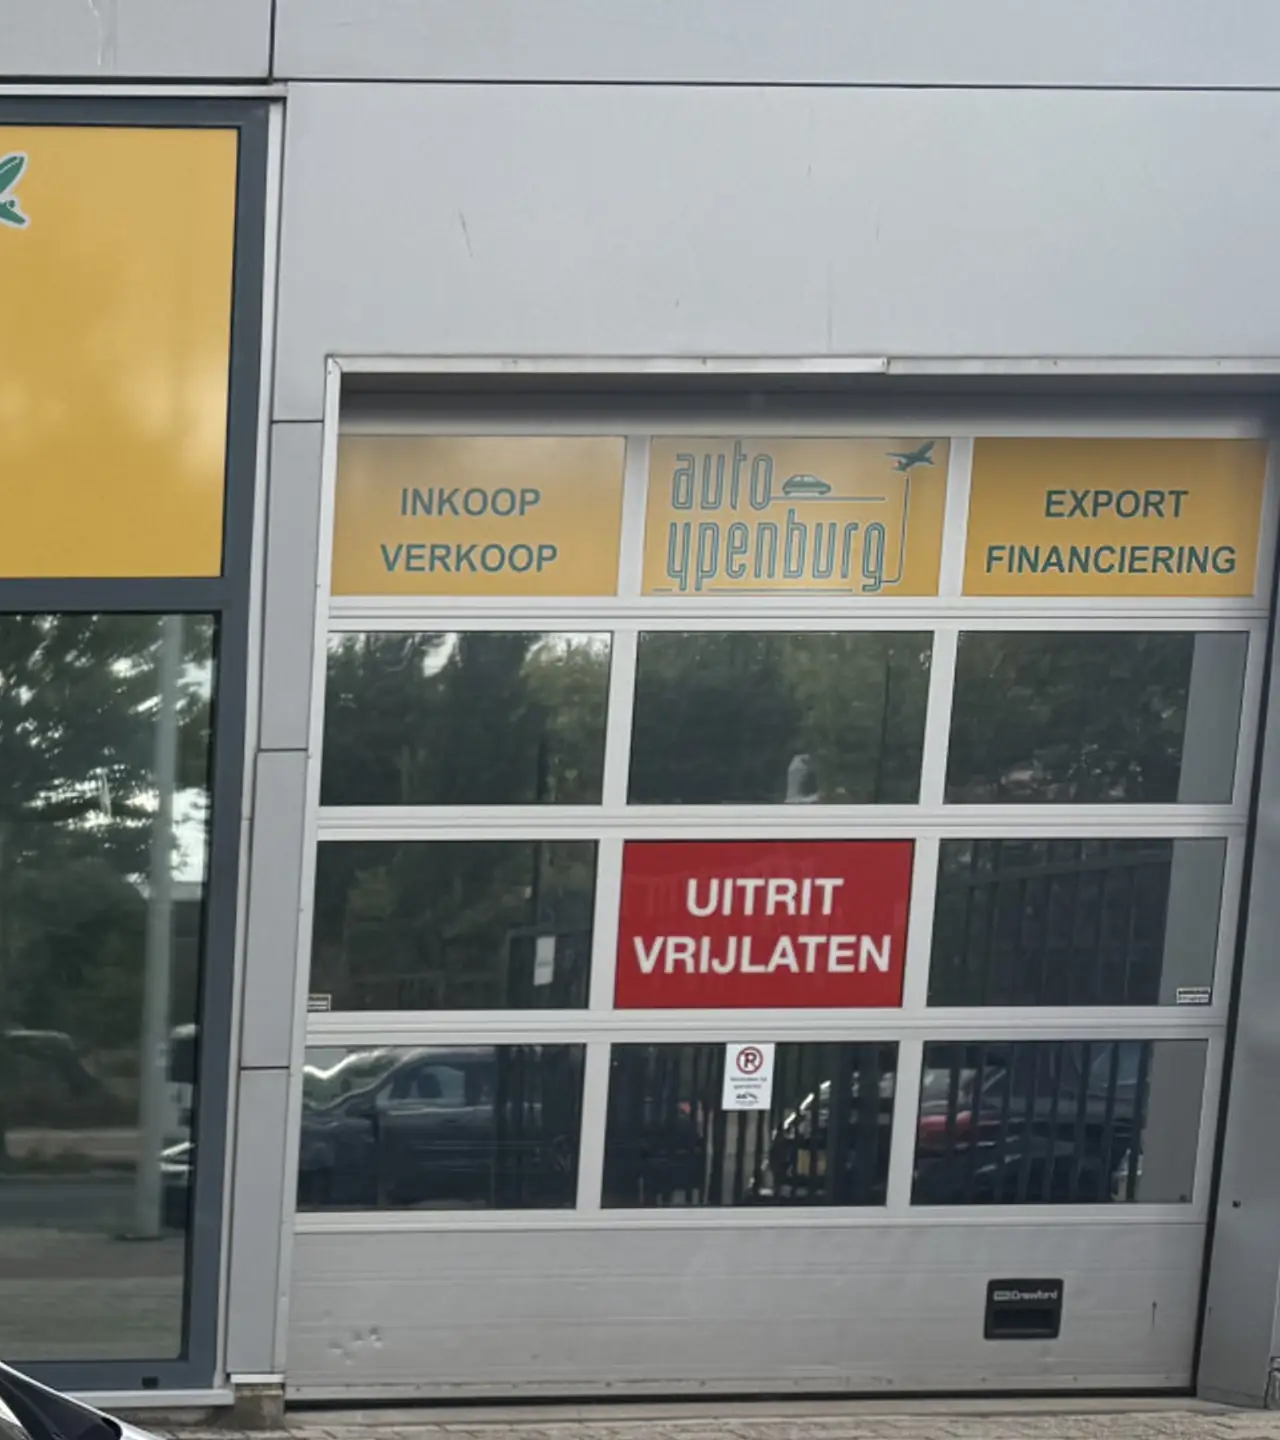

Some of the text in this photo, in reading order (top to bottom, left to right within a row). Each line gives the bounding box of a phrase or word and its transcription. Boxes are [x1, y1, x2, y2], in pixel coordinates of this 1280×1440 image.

[670, 440, 774, 511] auto
[399, 487, 541, 518] INKOOP
[1044, 488, 1189, 519] EXPORT
[380, 542, 558, 574] VERKOOP
[666, 507, 888, 593] ypenburg
[985, 544, 1237, 575] FINANCIERING
[686, 876, 844, 917] UITRIT
[634, 934, 892, 975] VRIJLATEN
